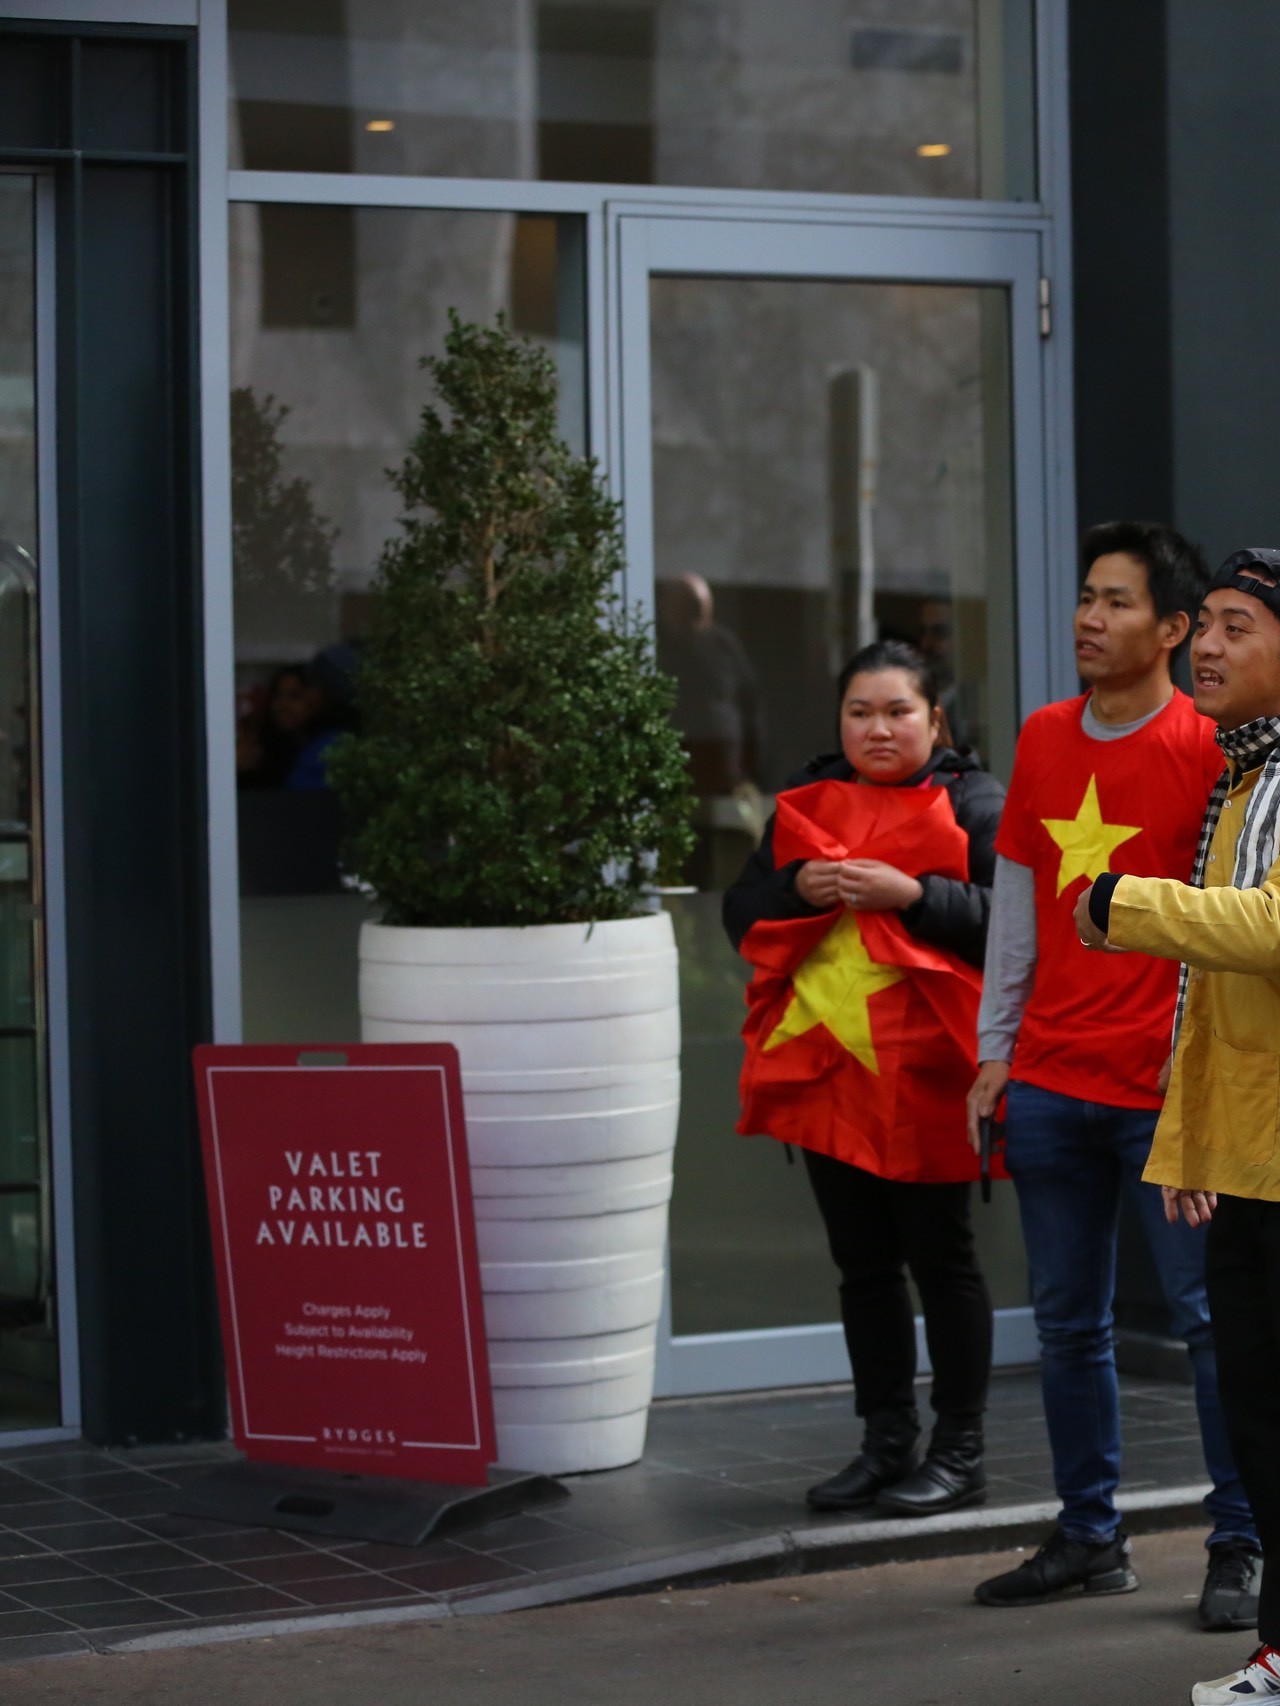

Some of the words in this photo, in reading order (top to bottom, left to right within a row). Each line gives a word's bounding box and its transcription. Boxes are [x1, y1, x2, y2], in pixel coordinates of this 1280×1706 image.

[285, 1151, 381, 1178] VALET
[269, 1186, 404, 1213] PARKING
[256, 1222, 428, 1248] AVAILABLE
[302, 1302, 351, 1318] Charges
[354, 1304, 391, 1320] Apply
[284, 1322, 329, 1338] Subject
[331, 1325, 345, 1338] to
[348, 1325, 414, 1342] Availability
[274, 1344, 315, 1359] Height
[317, 1345, 388, 1360] Restrictions
[391, 1347, 428, 1364] Apply
[322, 1426, 396, 1443] RYDGES
